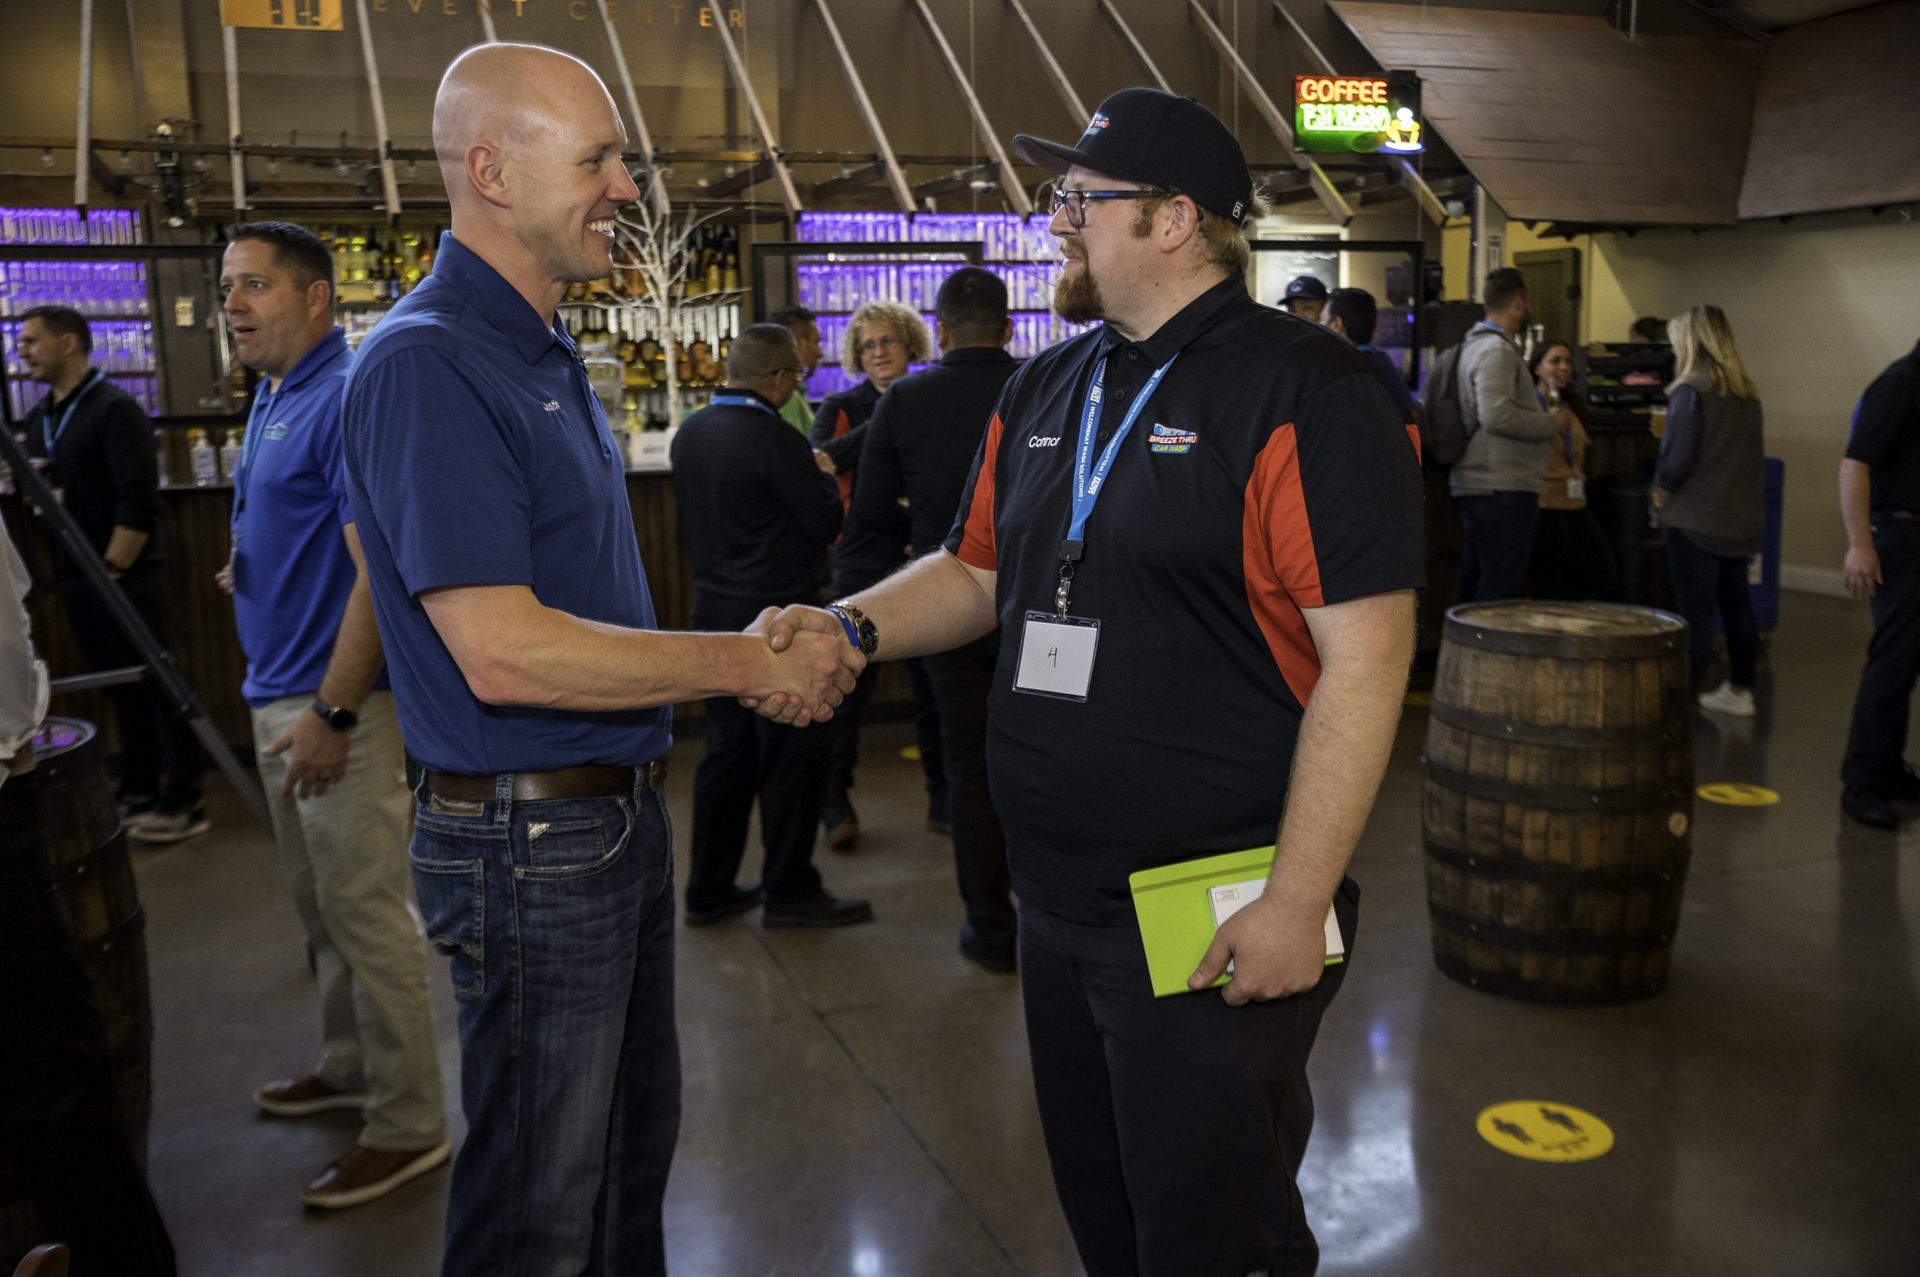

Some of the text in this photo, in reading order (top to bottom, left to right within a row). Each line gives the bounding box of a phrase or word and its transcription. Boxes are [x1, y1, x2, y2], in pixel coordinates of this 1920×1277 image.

[373, 0, 743, 28] EVENT CENTER
[1300, 79, 1388, 103] COFFEE
[1082, 405, 1096, 445] WELCOMEMAT
[1028, 435, 1061, 448] Connor
[1149, 435, 1197, 444] BREEZE THRU
[1078, 464, 1086, 498] SOLUTIONS
